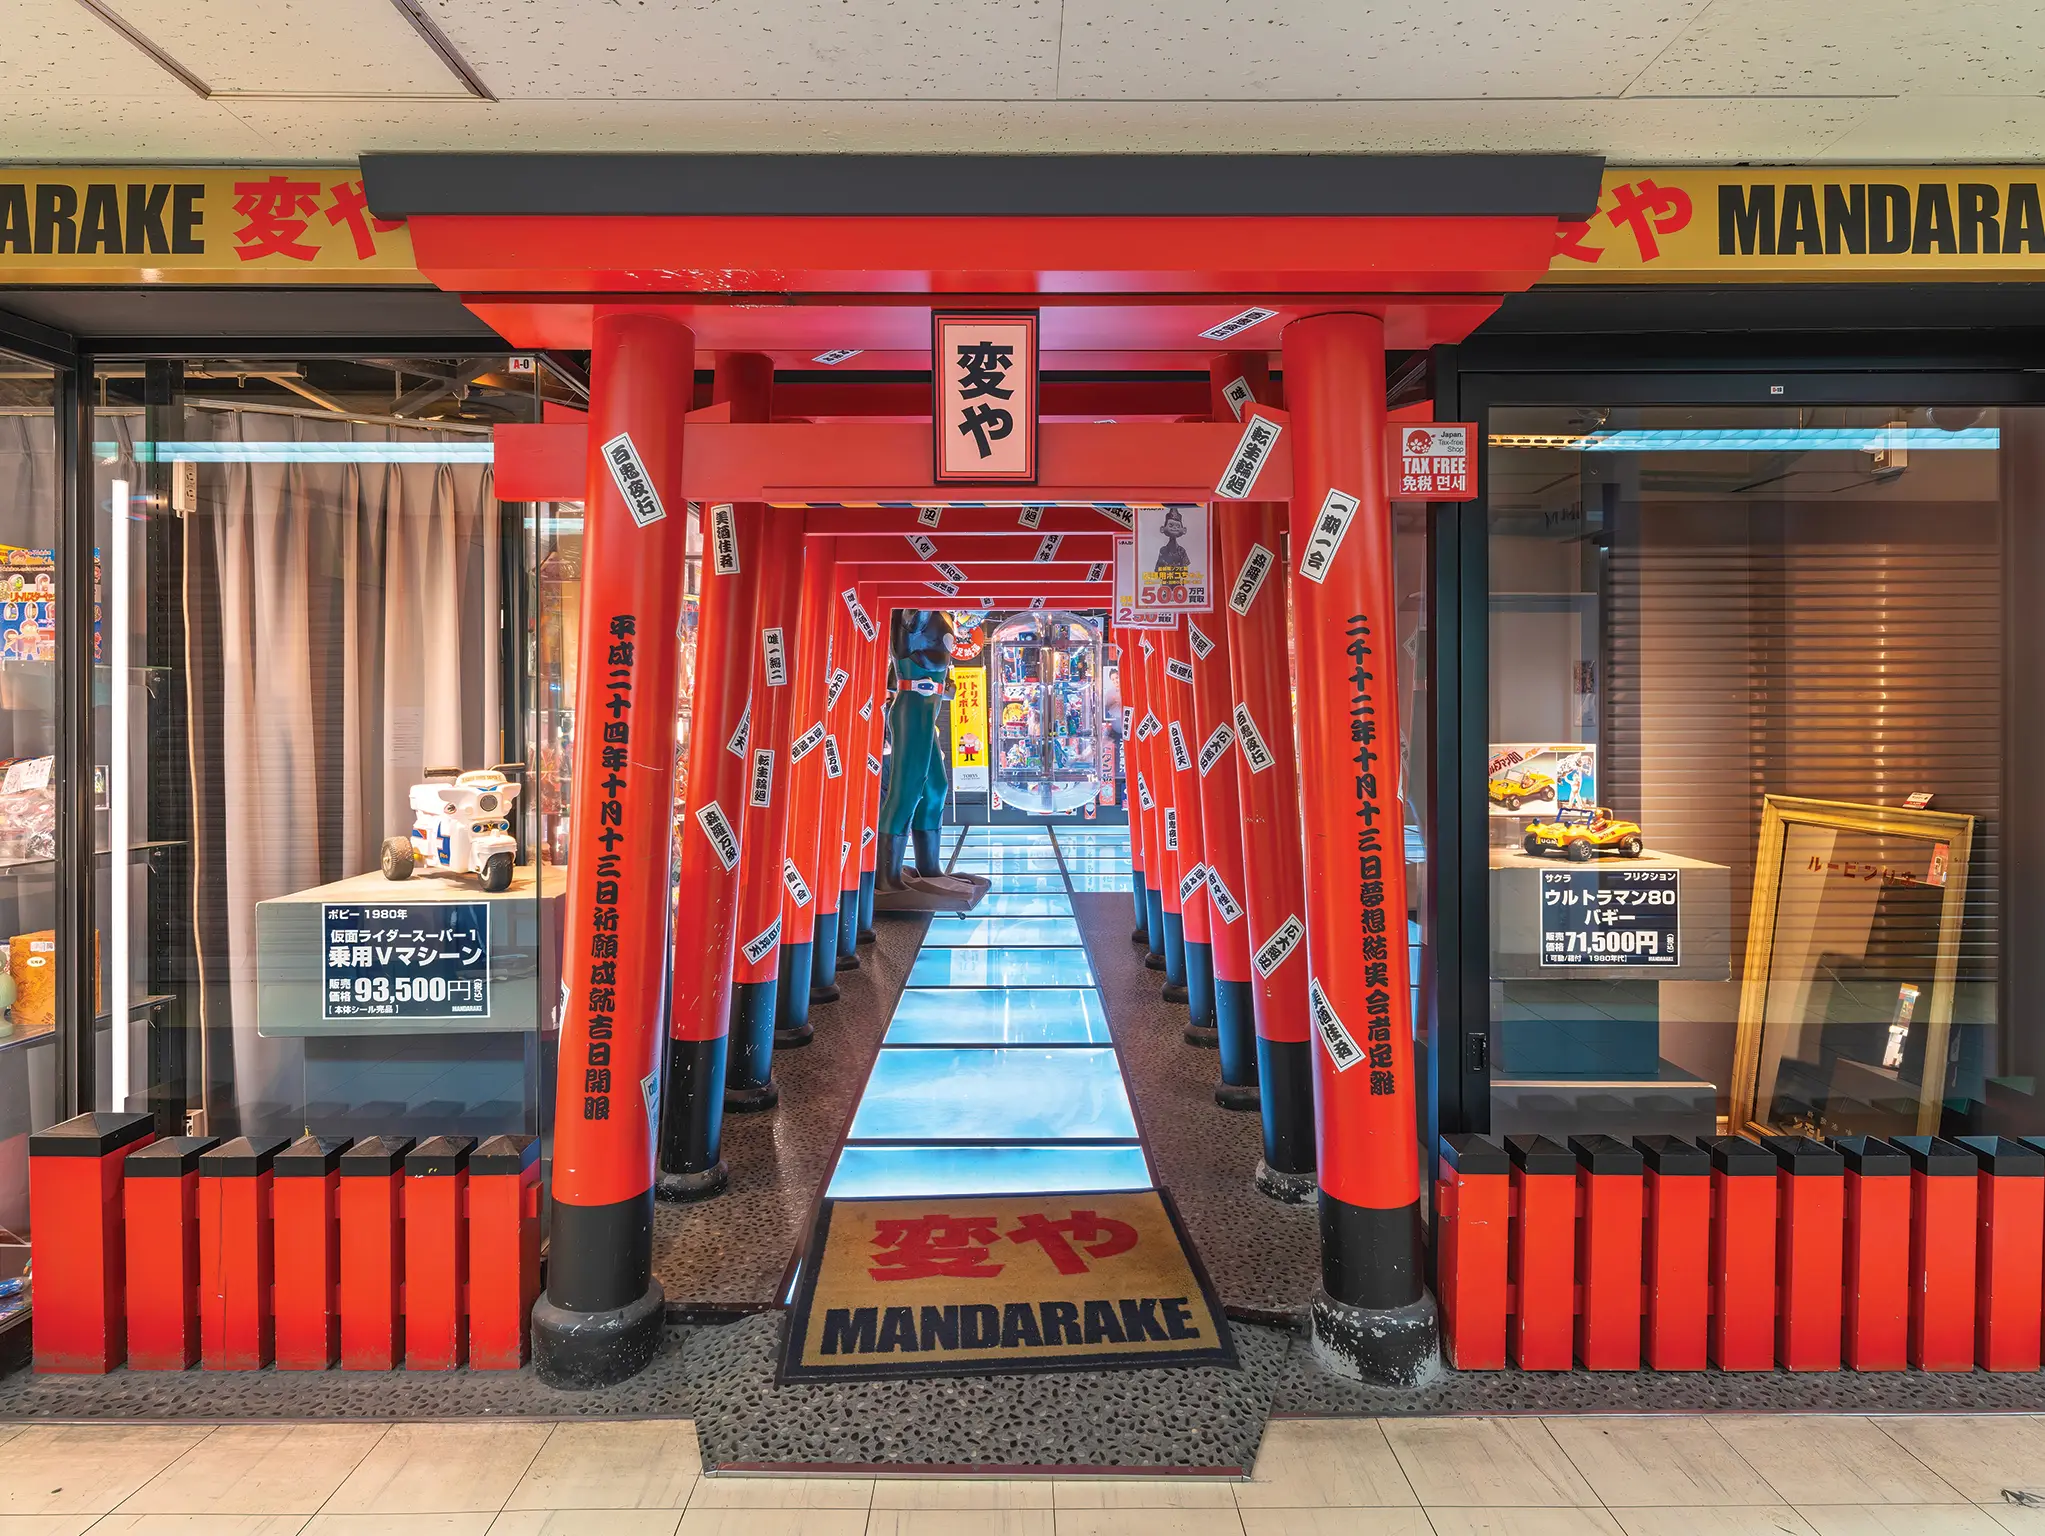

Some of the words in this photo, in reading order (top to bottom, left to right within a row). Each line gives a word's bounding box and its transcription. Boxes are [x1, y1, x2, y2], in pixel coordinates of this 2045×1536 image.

[0, 184, 205, 254] ARAKE
[1718, 183, 2045, 255] MANDARA
[957, 341, 1015, 459] 変や
[1228, 426, 1271, 494] 転生輪廻
[1447, 445, 1464, 453] Shop
[610, 444, 656, 516] 百鬼夜行
[1402, 458, 1430, 474] TAX
[1433, 458, 1466, 474] FREE
[1402, 475, 1432, 491] 免税
[1437, 475, 1466, 491] 면세
[1307, 502, 1348, 572] 一期一会
[1141, 586, 1188, 604] 500
[1189, 587, 1204, 595] 万円
[1234, 554, 1266, 607] 森羅万象
[959, 682, 969, 724] ハイボール
[971, 682, 979, 707] トリス
[1171, 728, 1187, 766] 白日昇天
[1237, 711, 1266, 765] 百鬼夜行
[705, 812, 737, 862] 森羅万象
[583, 615, 636, 1121] 平成二十四年十月十三日祈願成就吉日開眼
[1345, 614, 1396, 1096] 二千十二年十月十三日夢想結実会者定離
[1545, 874, 1571, 883] サクラ
[1623, 872, 1676, 881] フリクション
[1545, 889, 1676, 906] ウルトラマン80
[328, 909, 360, 920] ポピー
[364, 909, 408, 920] 1980年
[1584, 908, 1636, 926] バギー
[330, 929, 477, 944] 仮面ライダースーパー1
[1565, 931, 1658, 954] 71,500円
[328, 946, 482, 968] 乗用Vマシーン
[329, 978, 351, 990] 販売
[329, 991, 351, 1002] 価格
[354, 976, 471, 1004] 93,500円
[866, 1210, 1138, 1281] 変や
[819, 1296, 1201, 1355] MANDARAKE
